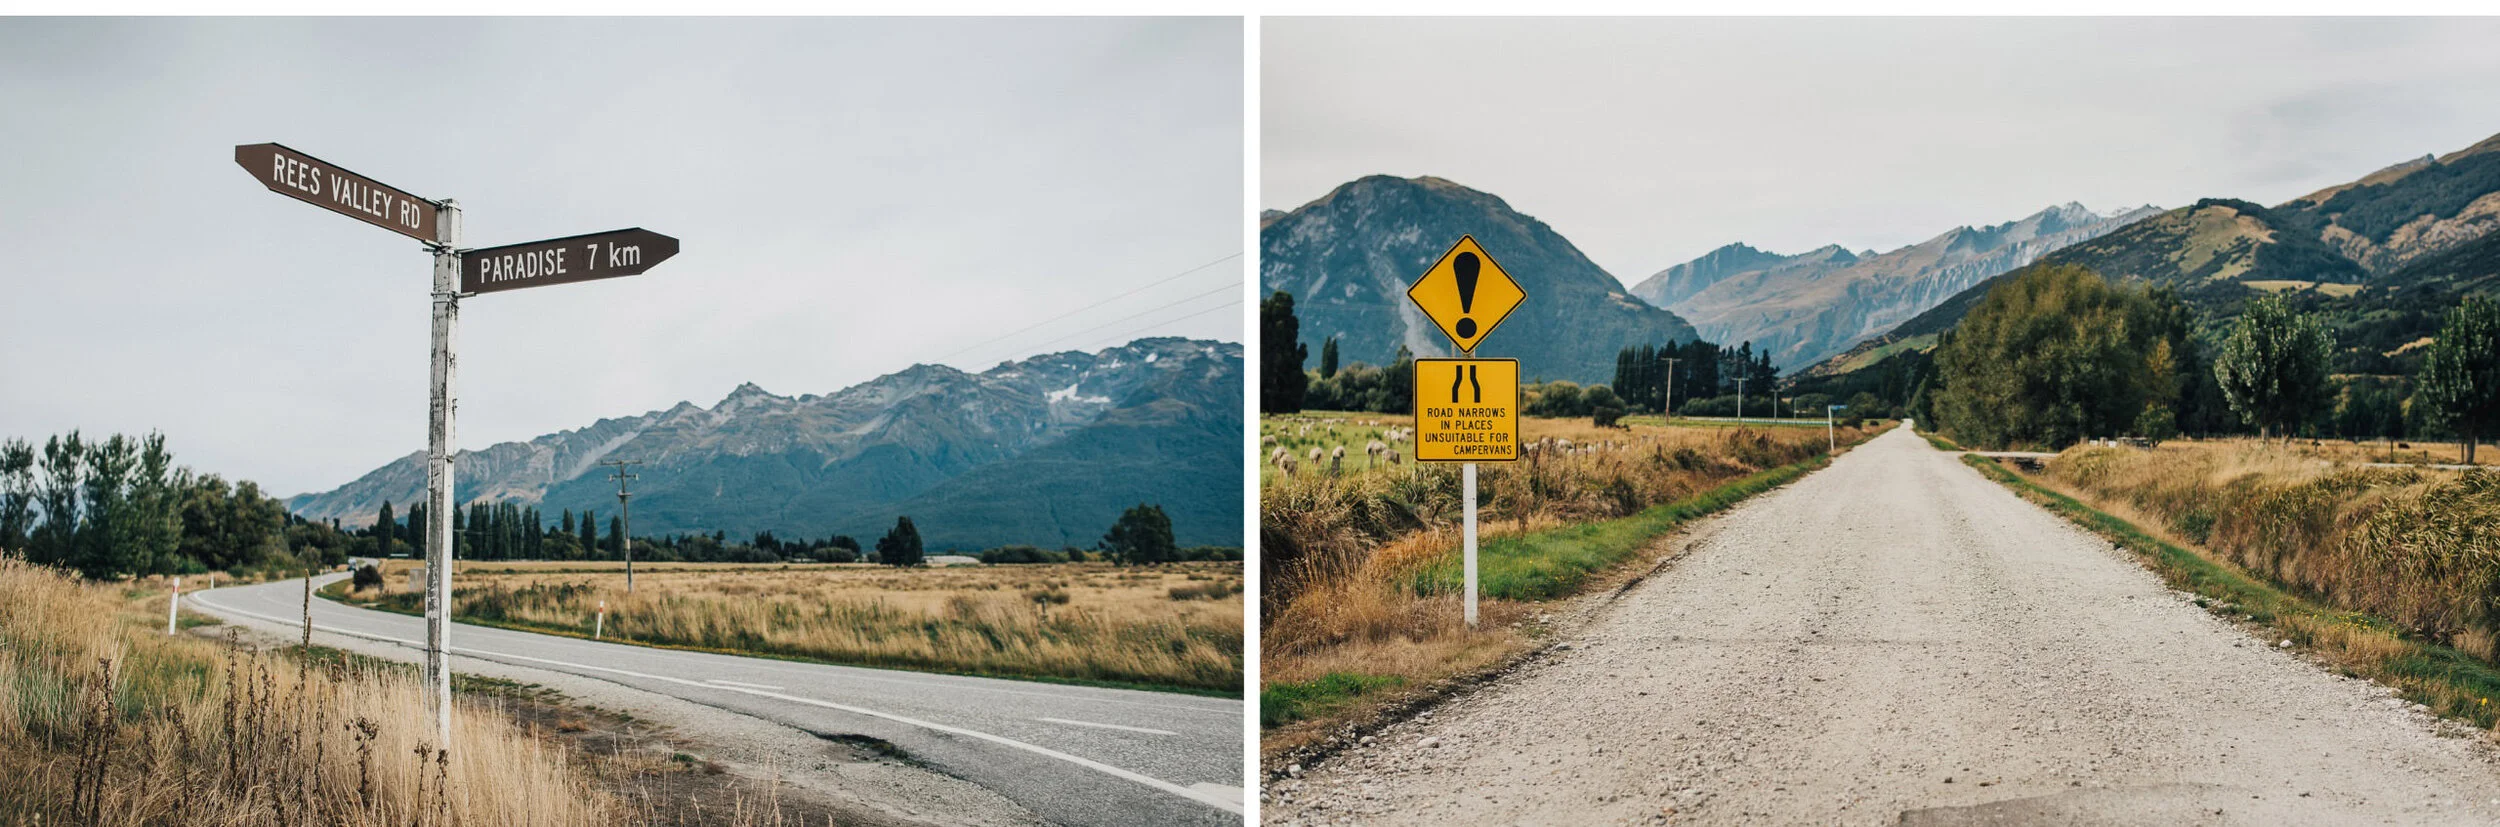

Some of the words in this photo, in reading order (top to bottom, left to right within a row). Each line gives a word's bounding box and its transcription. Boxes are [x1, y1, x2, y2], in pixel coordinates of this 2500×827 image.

[273, 152, 321, 195] REES
[331, 173, 393, 220] VALLEY
[401, 199, 420, 229] RD
[480, 248, 567, 284] PARADISE
[587, 244, 598, 271] 7
[608, 242, 641, 267] km
[1427, 408, 1453, 417] ROAD
[1459, 408, 1505, 417] NARROWS
[1441, 420, 1450, 430] IN
[1455, 420, 1493, 430] PLACES
[1425, 433, 1484, 443] UNSUITABLE
[1490, 433, 1508, 443] FOR
[1454, 445, 1512, 455] CAMPERVANS
